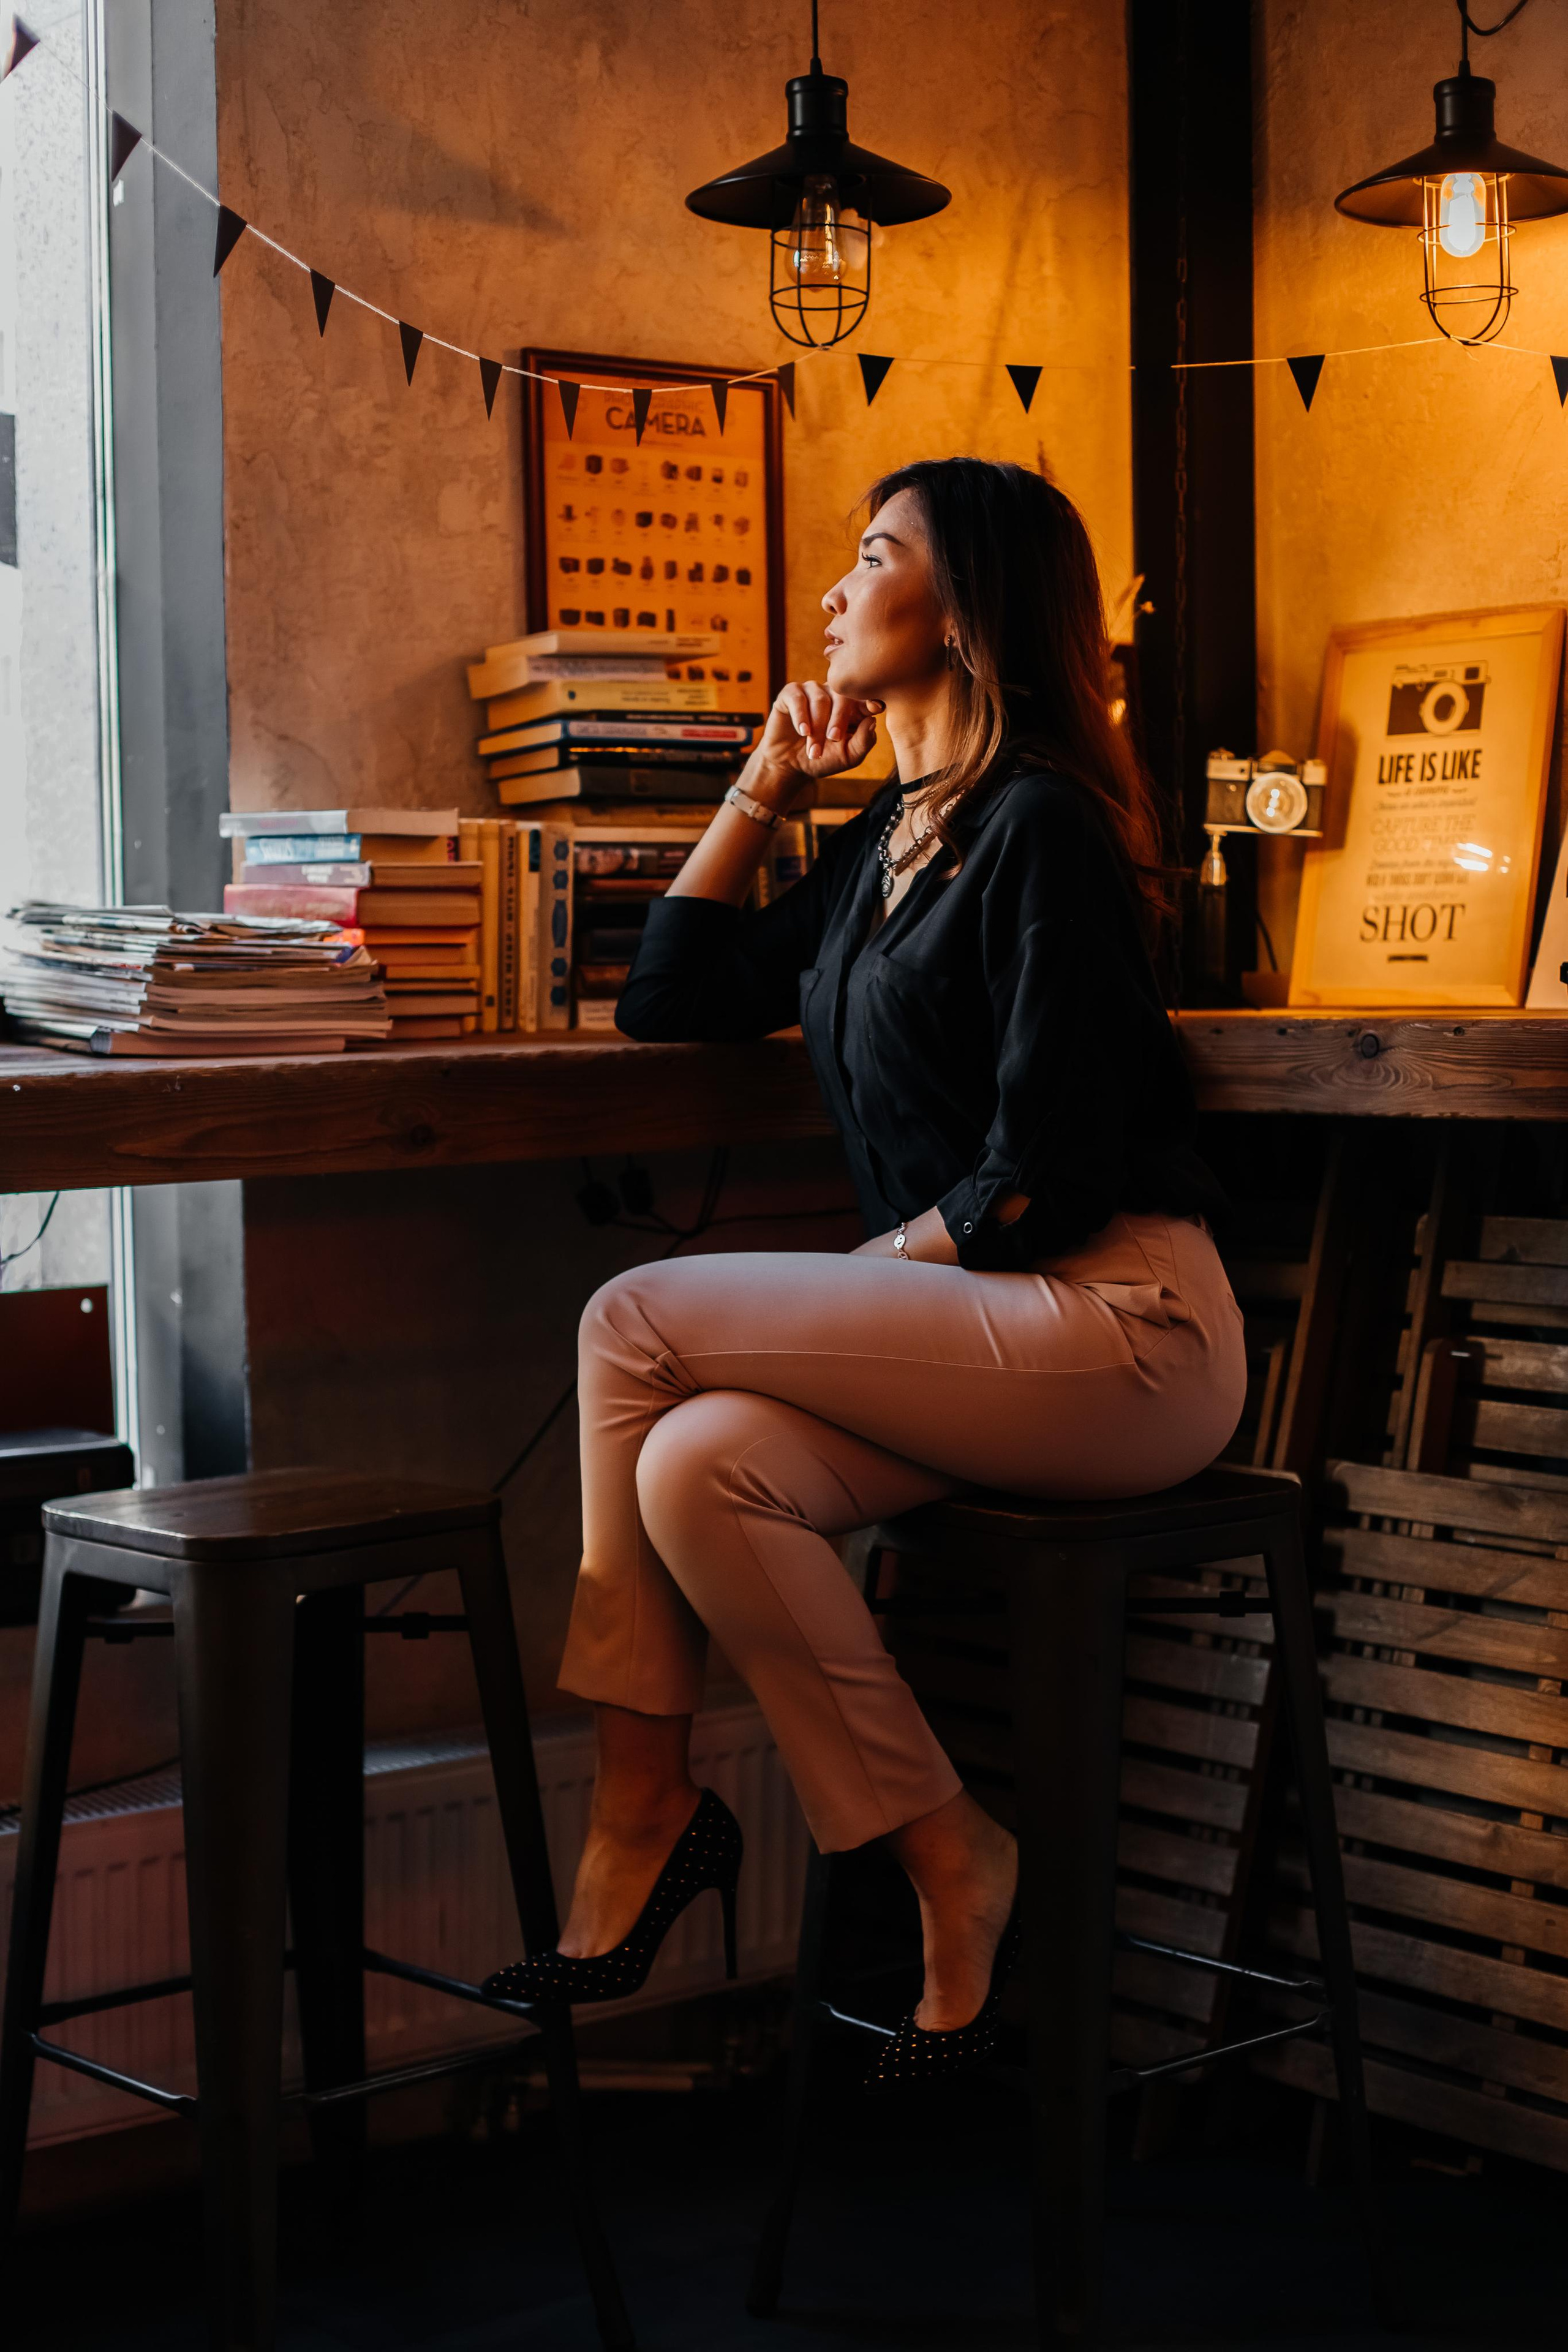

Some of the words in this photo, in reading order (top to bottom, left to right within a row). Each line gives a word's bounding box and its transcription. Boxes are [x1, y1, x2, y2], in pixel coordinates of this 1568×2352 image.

[1378, 753, 1415, 784] LIFE
[1420, 752, 1438, 782] IS
[1441, 748, 1482, 780] LIKE
[1359, 902, 1466, 943] SHOT
